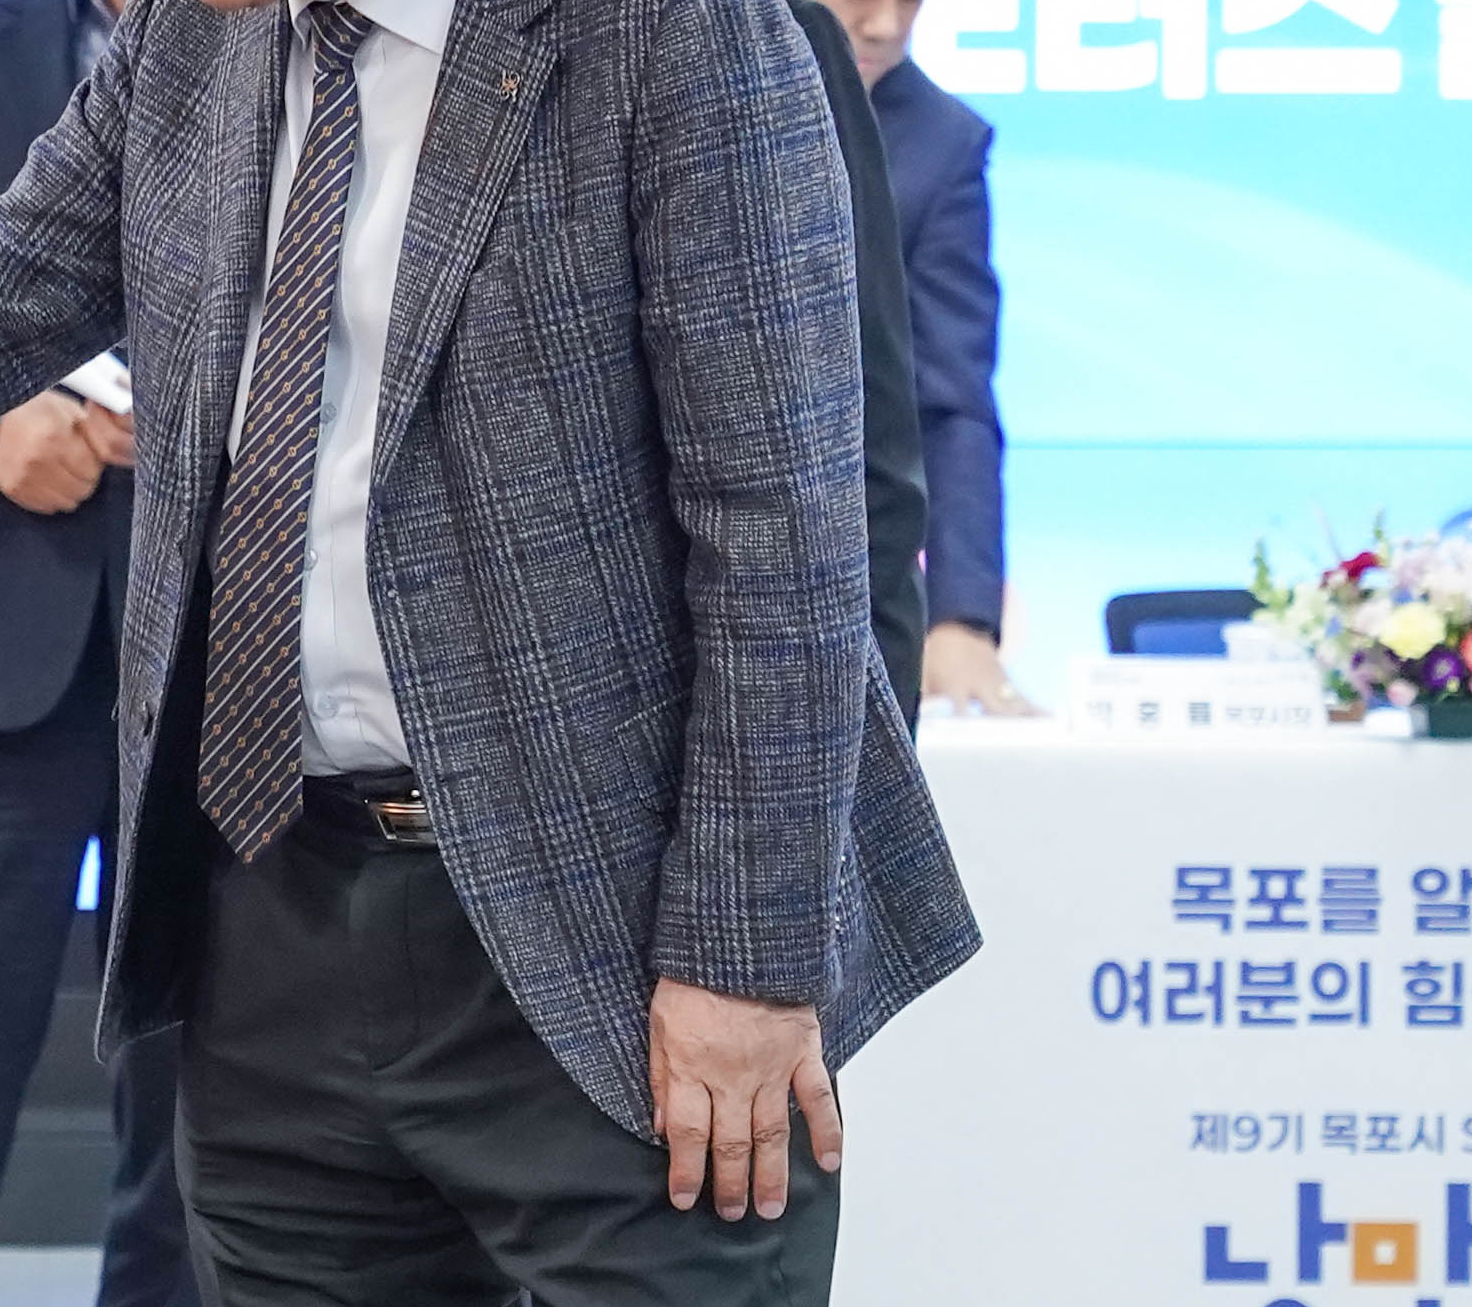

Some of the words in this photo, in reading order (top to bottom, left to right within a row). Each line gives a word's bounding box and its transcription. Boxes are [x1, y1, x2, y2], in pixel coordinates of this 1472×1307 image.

[1171, 865, 1382, 934] 목포를
[1090, 958, 1371, 1028] 여러분의
[1189, 1112, 1305, 1155] 제9기
[1320, 1112, 1447, 1156] 목포시
